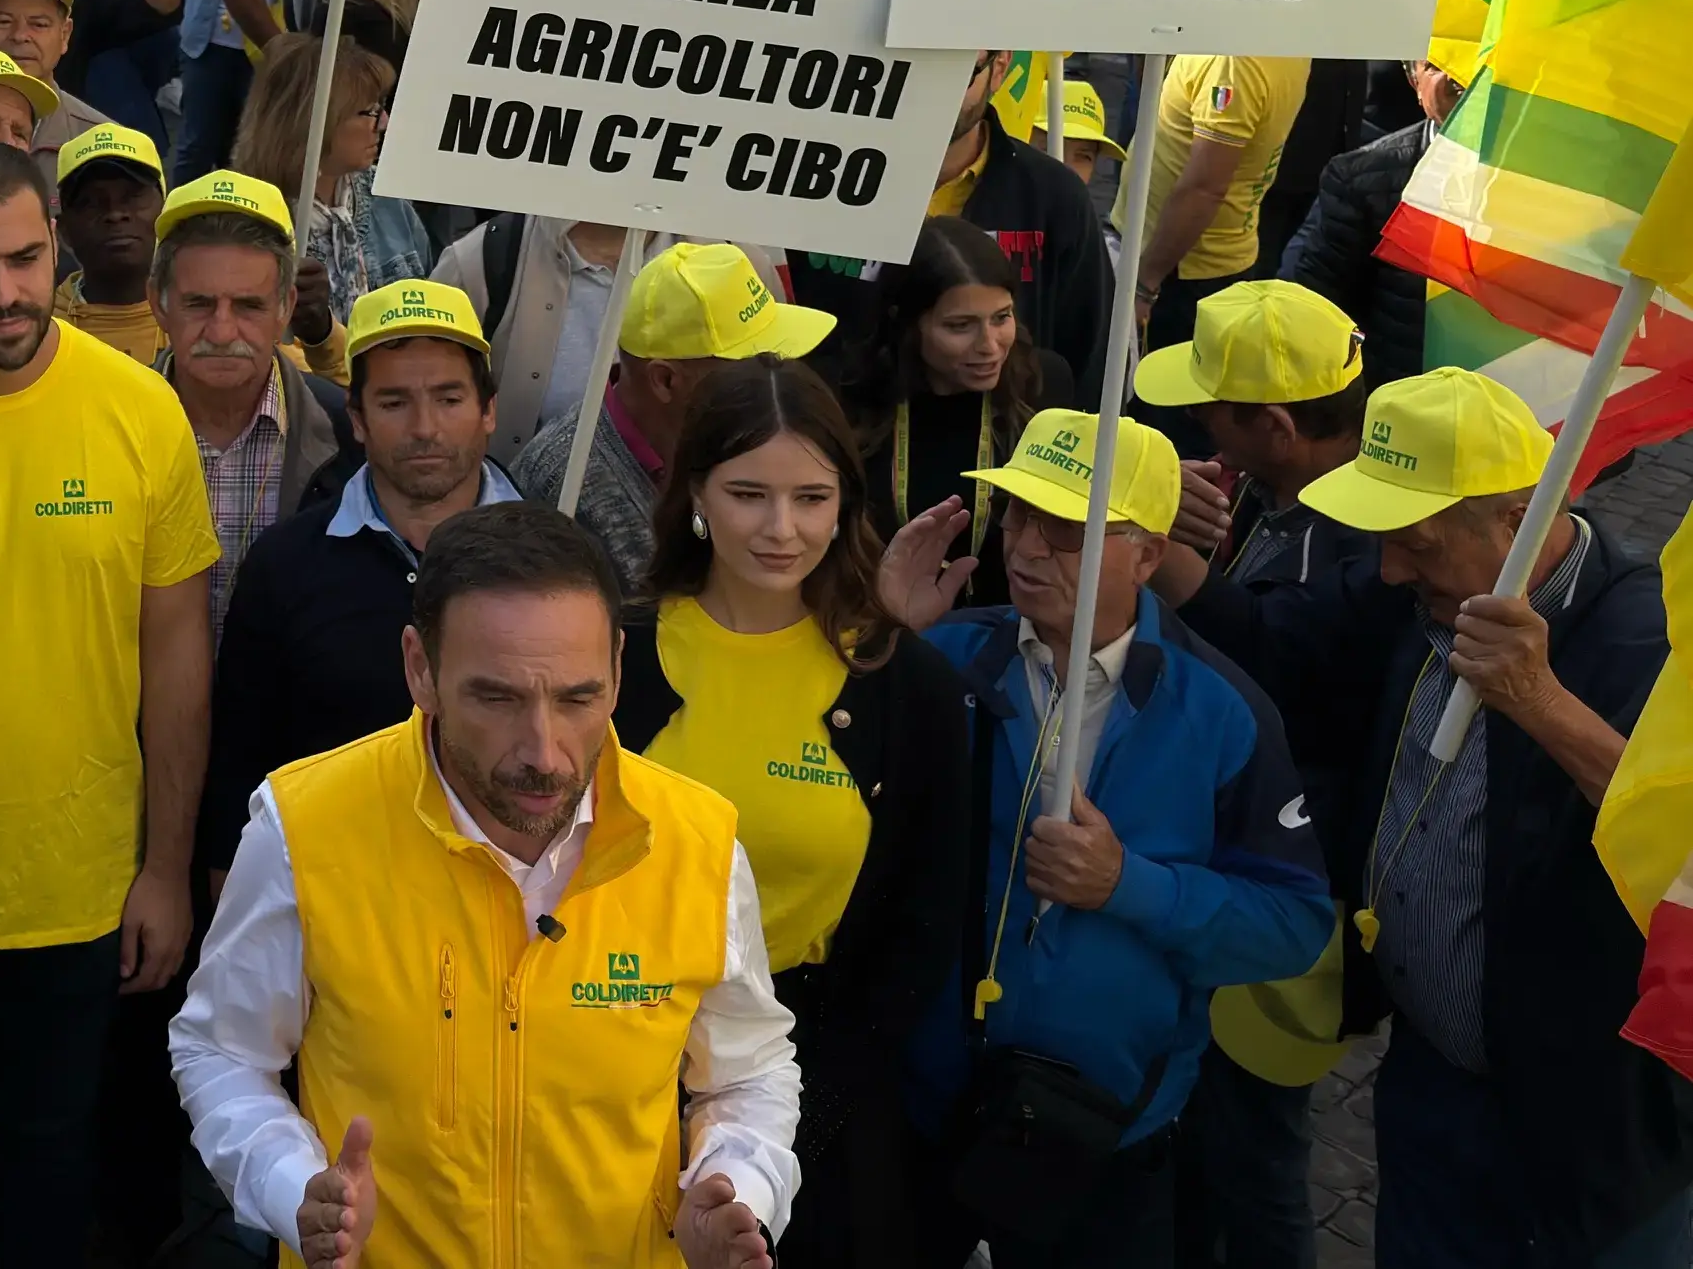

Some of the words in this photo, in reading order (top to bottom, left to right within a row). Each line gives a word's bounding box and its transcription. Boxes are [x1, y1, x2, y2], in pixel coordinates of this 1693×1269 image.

[467, 7, 912, 120] AGRICOLTORI
[75, 142, 136, 159] COLDIRETTI
[438, 94, 584, 167] NON
[726, 133, 887, 207] CIBO
[380, 307, 455, 326] COLDIRETTI
[35, 501, 113, 516] COLDIRETTI
[572, 982, 674, 1002] COLDIRETTI
